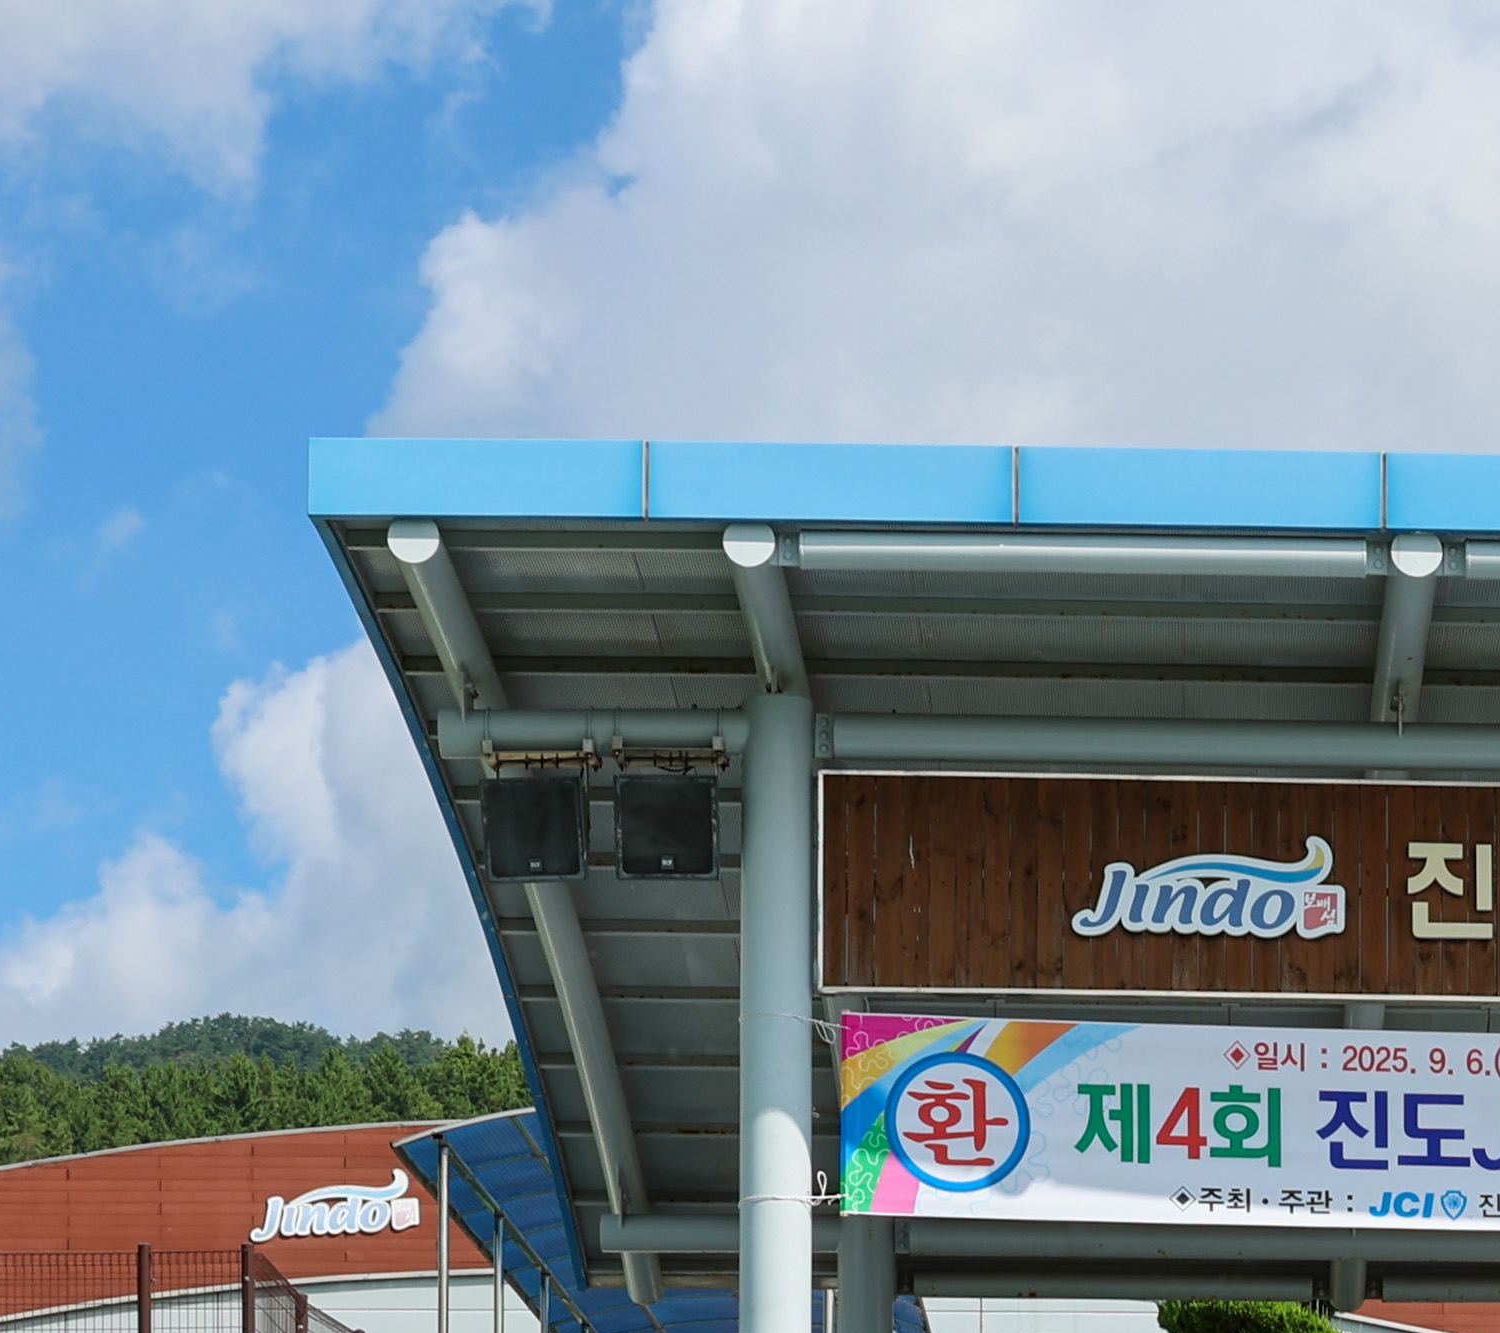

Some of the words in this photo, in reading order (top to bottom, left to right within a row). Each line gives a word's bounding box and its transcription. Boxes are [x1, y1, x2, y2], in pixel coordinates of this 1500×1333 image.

[1075, 868, 1298, 938] Jindo
[1254, 1042, 1307, 1072] 일시
[1341, 1045, 1418, 1075] 2025.
[902, 1078, 1009, 1166] 환
[1074, 1083, 1283, 1168] 제4회
[253, 1197, 390, 1241] Jindo
[1197, 1187, 1252, 1213] 주최
[1277, 1189, 1333, 1216] 주관
[1368, 1191, 1435, 1219] JCI
